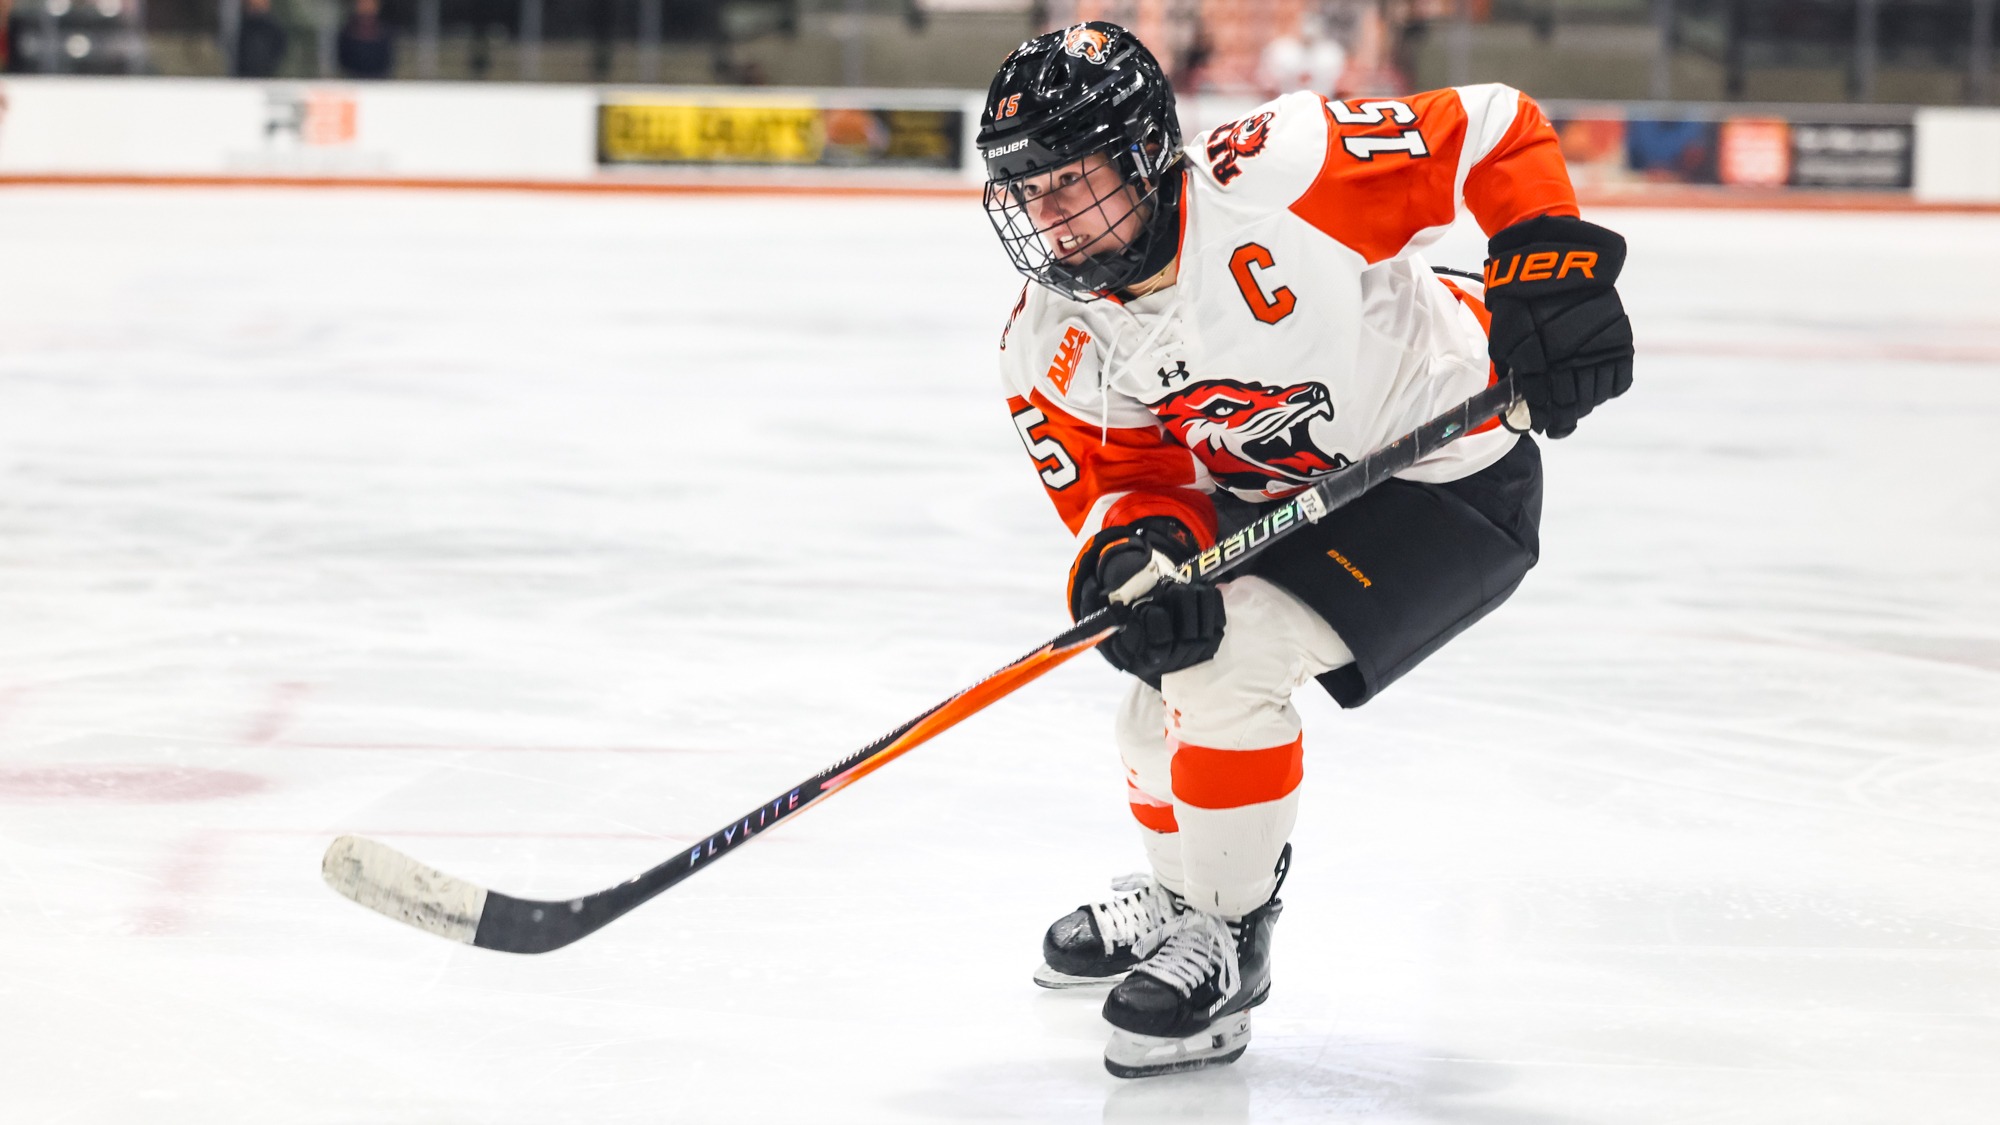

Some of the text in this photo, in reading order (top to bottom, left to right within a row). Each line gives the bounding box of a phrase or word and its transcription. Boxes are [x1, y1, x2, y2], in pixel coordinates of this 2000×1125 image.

[995, 93, 1023, 120] 15
[1326, 98, 1430, 162] 15
[988, 138, 1029, 159] BAUER
[1207, 120, 1242, 187] RIT
[1228, 242, 1297, 325] C
[1484, 250, 1599, 288] UER
[1326, 548, 1373, 589] BAUER
[689, 788, 801, 867] FLYLITE
